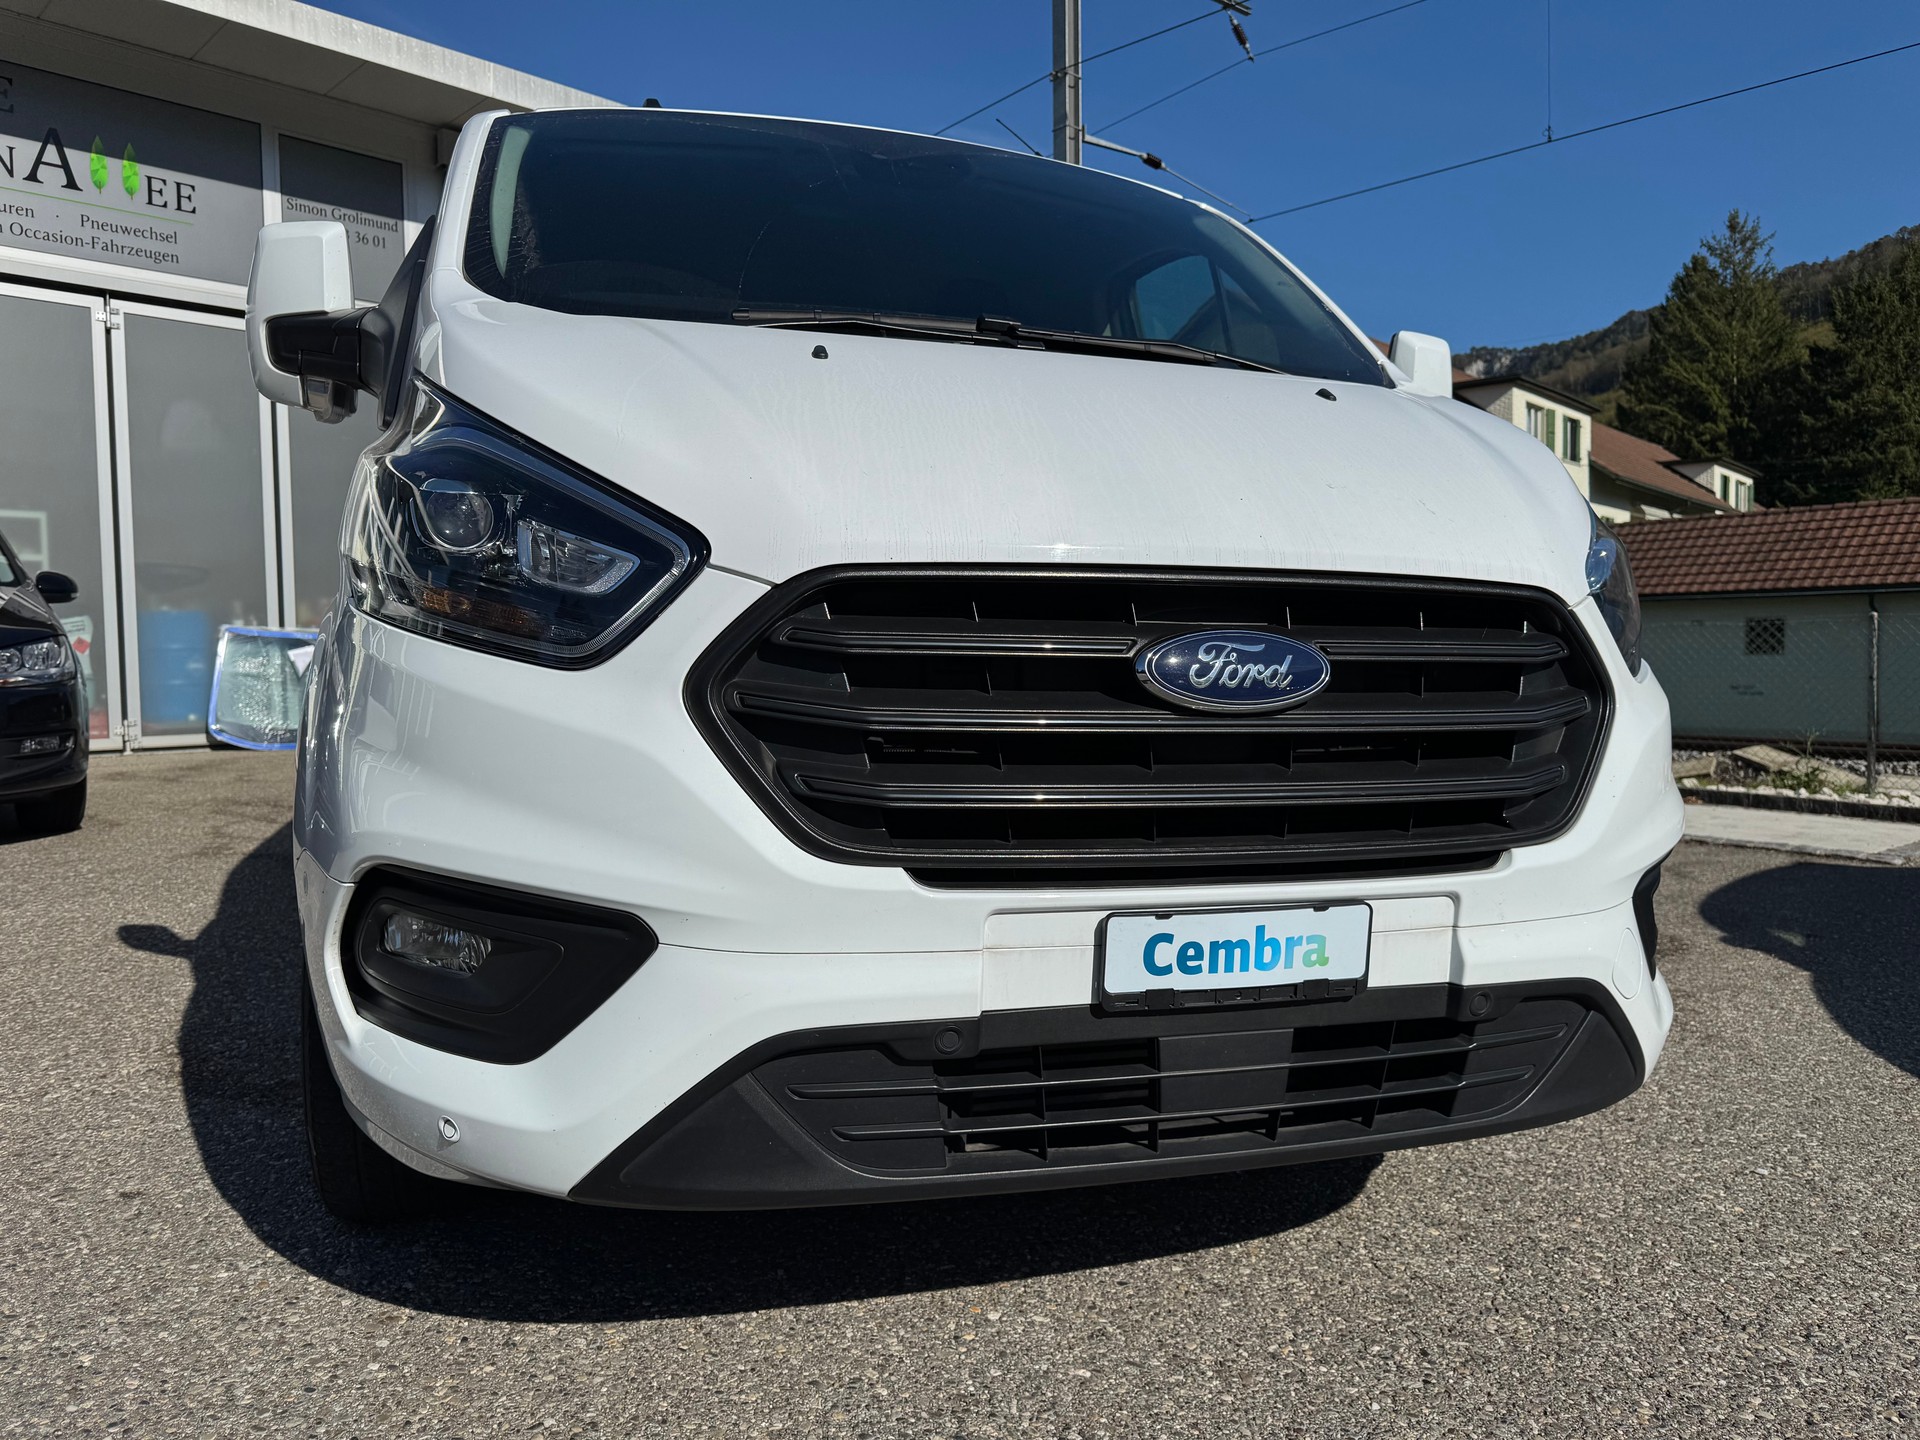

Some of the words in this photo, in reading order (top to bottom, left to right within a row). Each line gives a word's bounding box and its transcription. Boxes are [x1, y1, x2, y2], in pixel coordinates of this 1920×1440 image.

[80, 213, 178, 244] Pneuwechsel
[286, 197, 328, 218] Simon
[331, 207, 399, 232] Grolimund
[9, 222, 180, 264] Occasion-Fahrzeugen
[1189, 641, 1293, 689] Ford
[1142, 925, 1329, 977] Cembra
